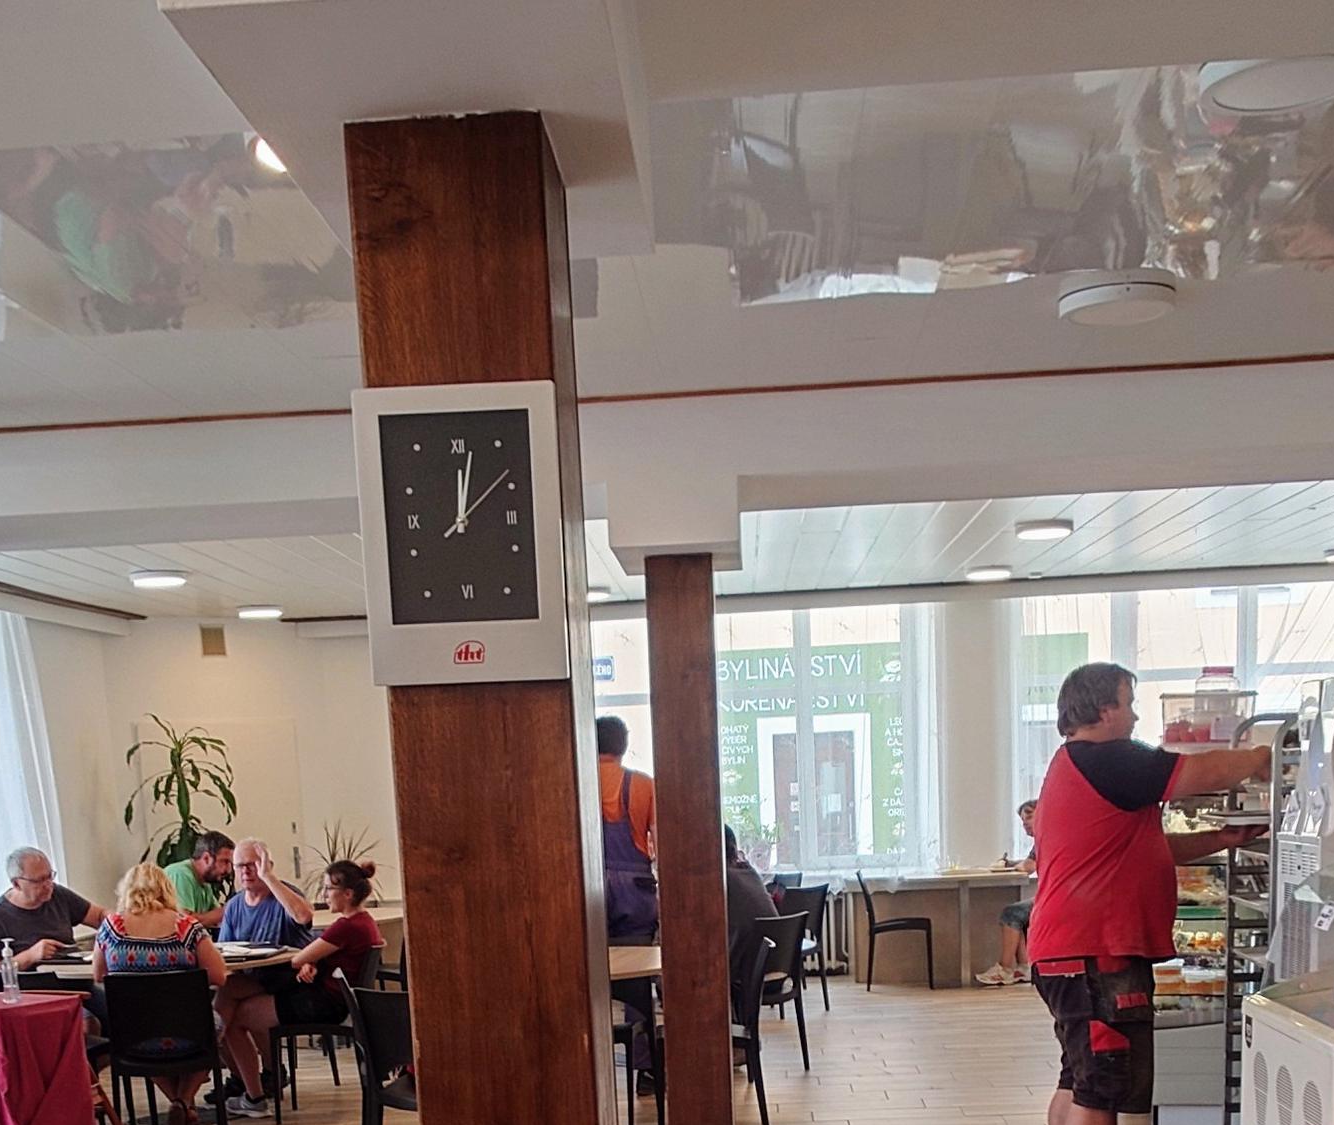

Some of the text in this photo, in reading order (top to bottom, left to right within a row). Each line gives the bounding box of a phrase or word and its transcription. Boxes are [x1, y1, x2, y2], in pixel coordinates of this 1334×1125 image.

[450, 438, 465, 455] XII
[407, 514, 420, 530] IX
[461, 584, 474, 599] VI
